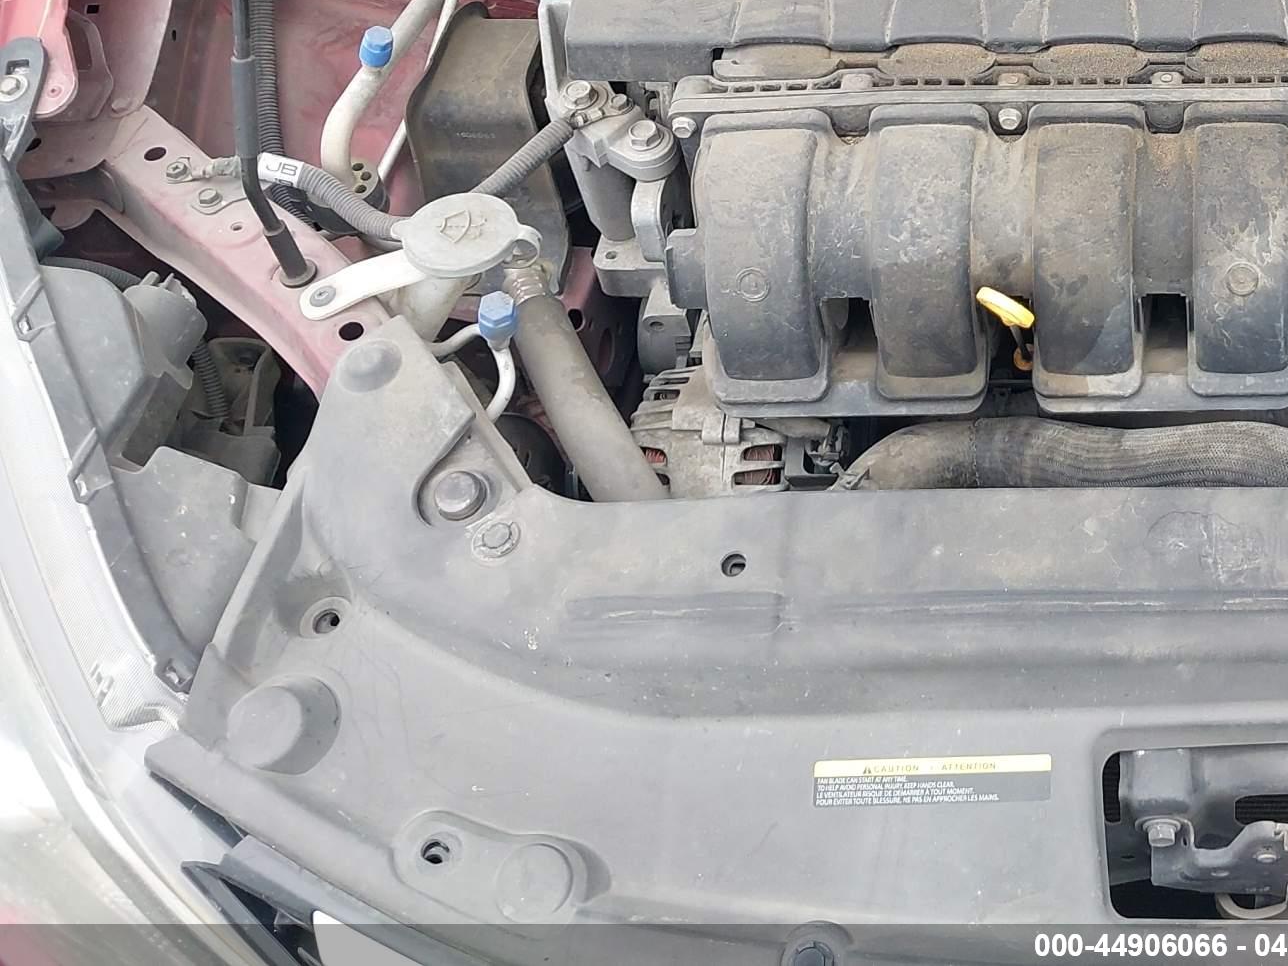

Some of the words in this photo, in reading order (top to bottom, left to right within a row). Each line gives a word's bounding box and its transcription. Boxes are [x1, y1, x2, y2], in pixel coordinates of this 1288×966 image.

[874, 765, 919, 773] CAUTION
[941, 762, 996, 771] ATTENTION
[815, 798, 832, 806] POUR
[853, 797, 871, 805] TOUTE
[932, 794, 967, 802] APPROCHER
